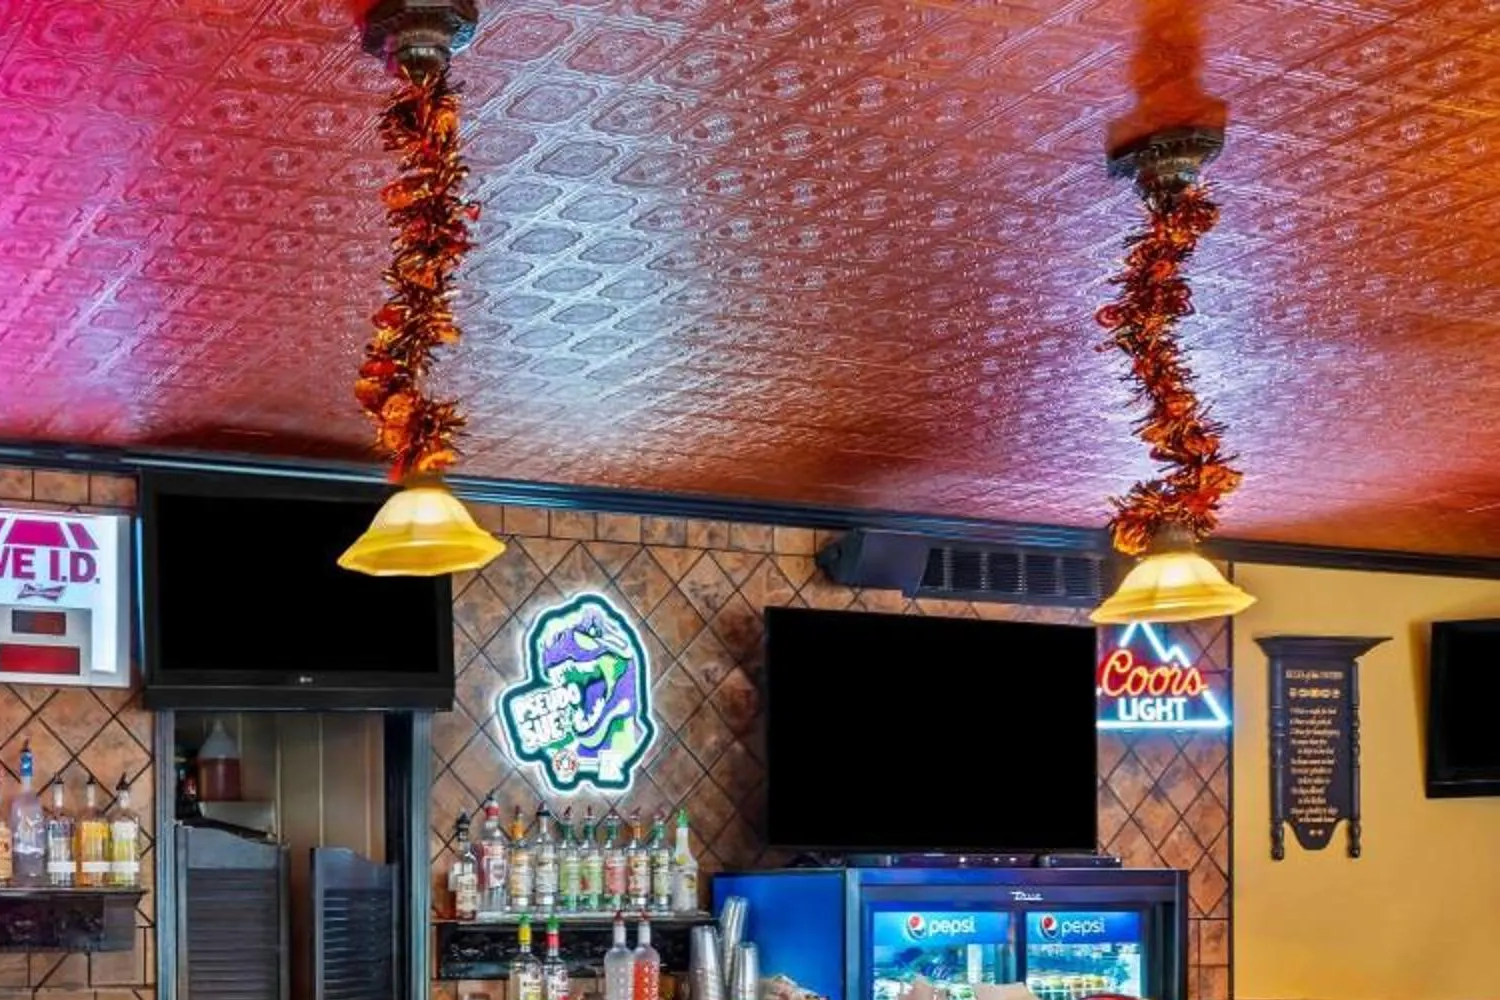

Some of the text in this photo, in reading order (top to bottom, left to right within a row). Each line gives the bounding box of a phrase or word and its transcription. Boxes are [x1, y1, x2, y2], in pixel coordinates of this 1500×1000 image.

[50, 549, 101, 584] I.D.
[1101, 649, 1209, 697] Coors
[1117, 697, 1187, 721] LIGHT
[928, 916, 976, 936] pepsi
[1061, 916, 1106, 936] pepsi
